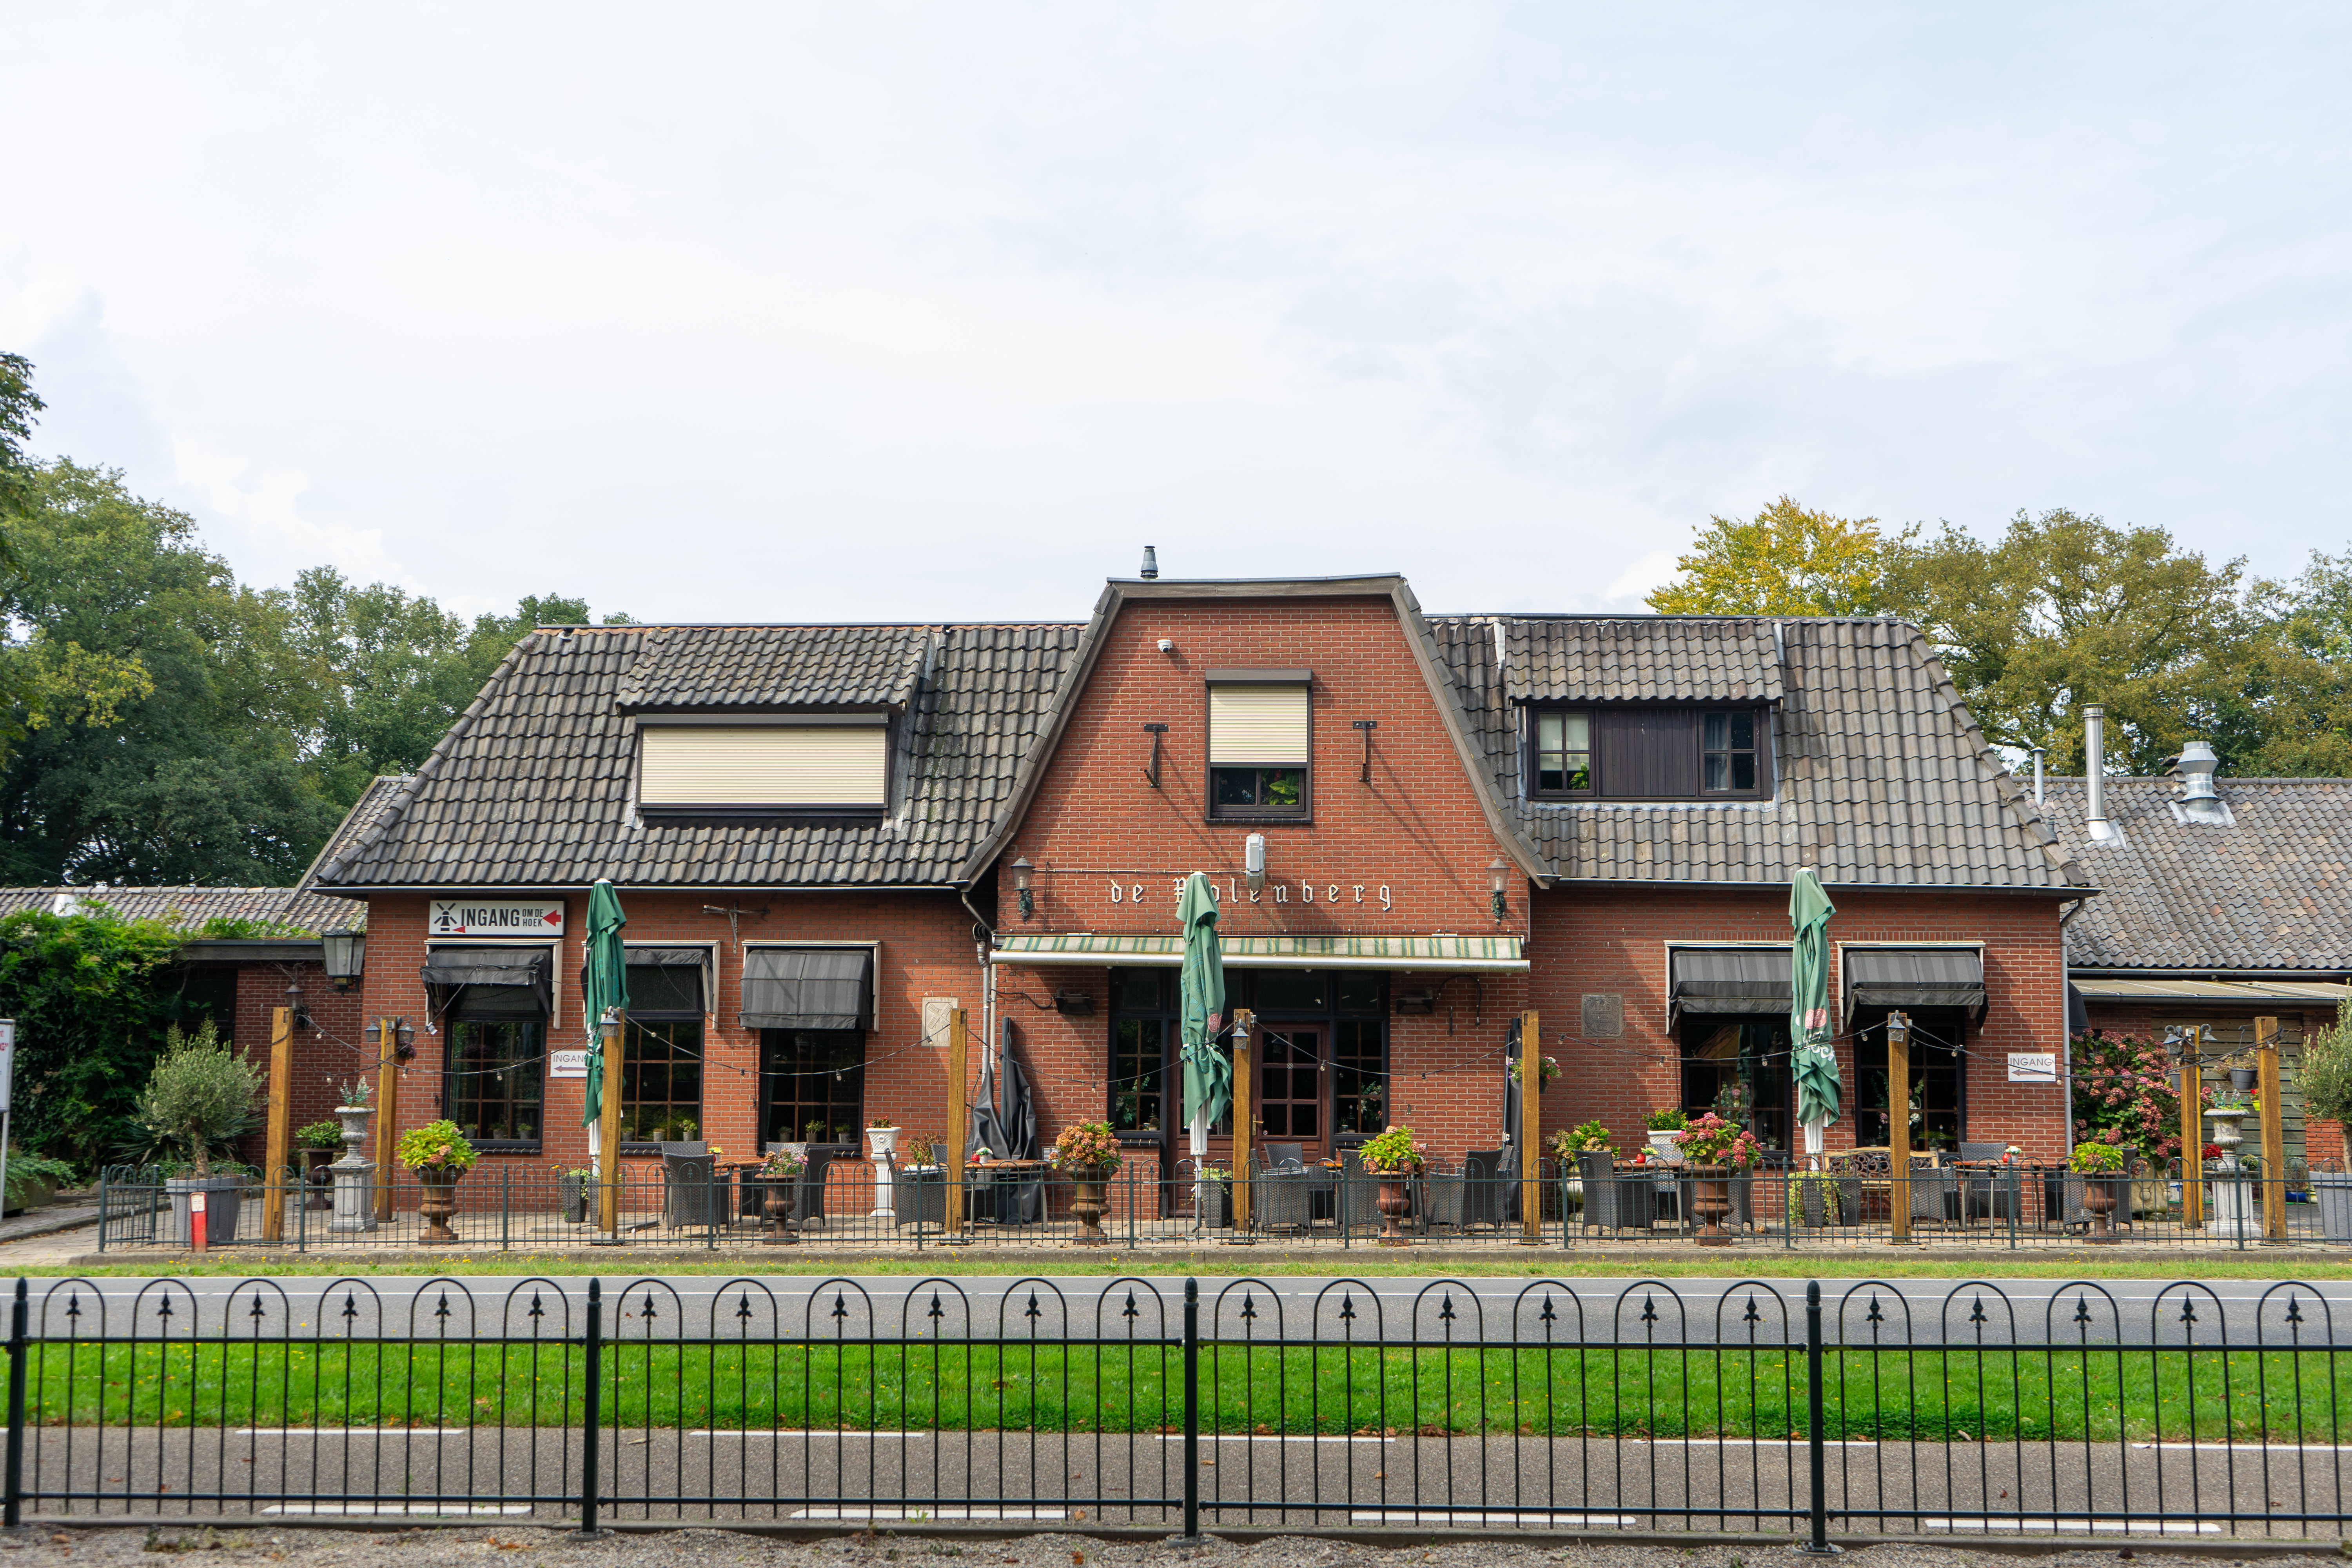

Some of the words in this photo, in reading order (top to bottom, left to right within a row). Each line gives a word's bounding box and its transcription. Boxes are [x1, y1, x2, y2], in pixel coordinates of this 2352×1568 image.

[1111, 879, 1143, 903] de
[461, 908, 520, 927] INGANG
[522, 909, 533, 917] OM
[535, 909, 543, 917] DE
[523, 918, 543, 927] HOEK
[2010, 1058, 2053, 1066] INGANG
